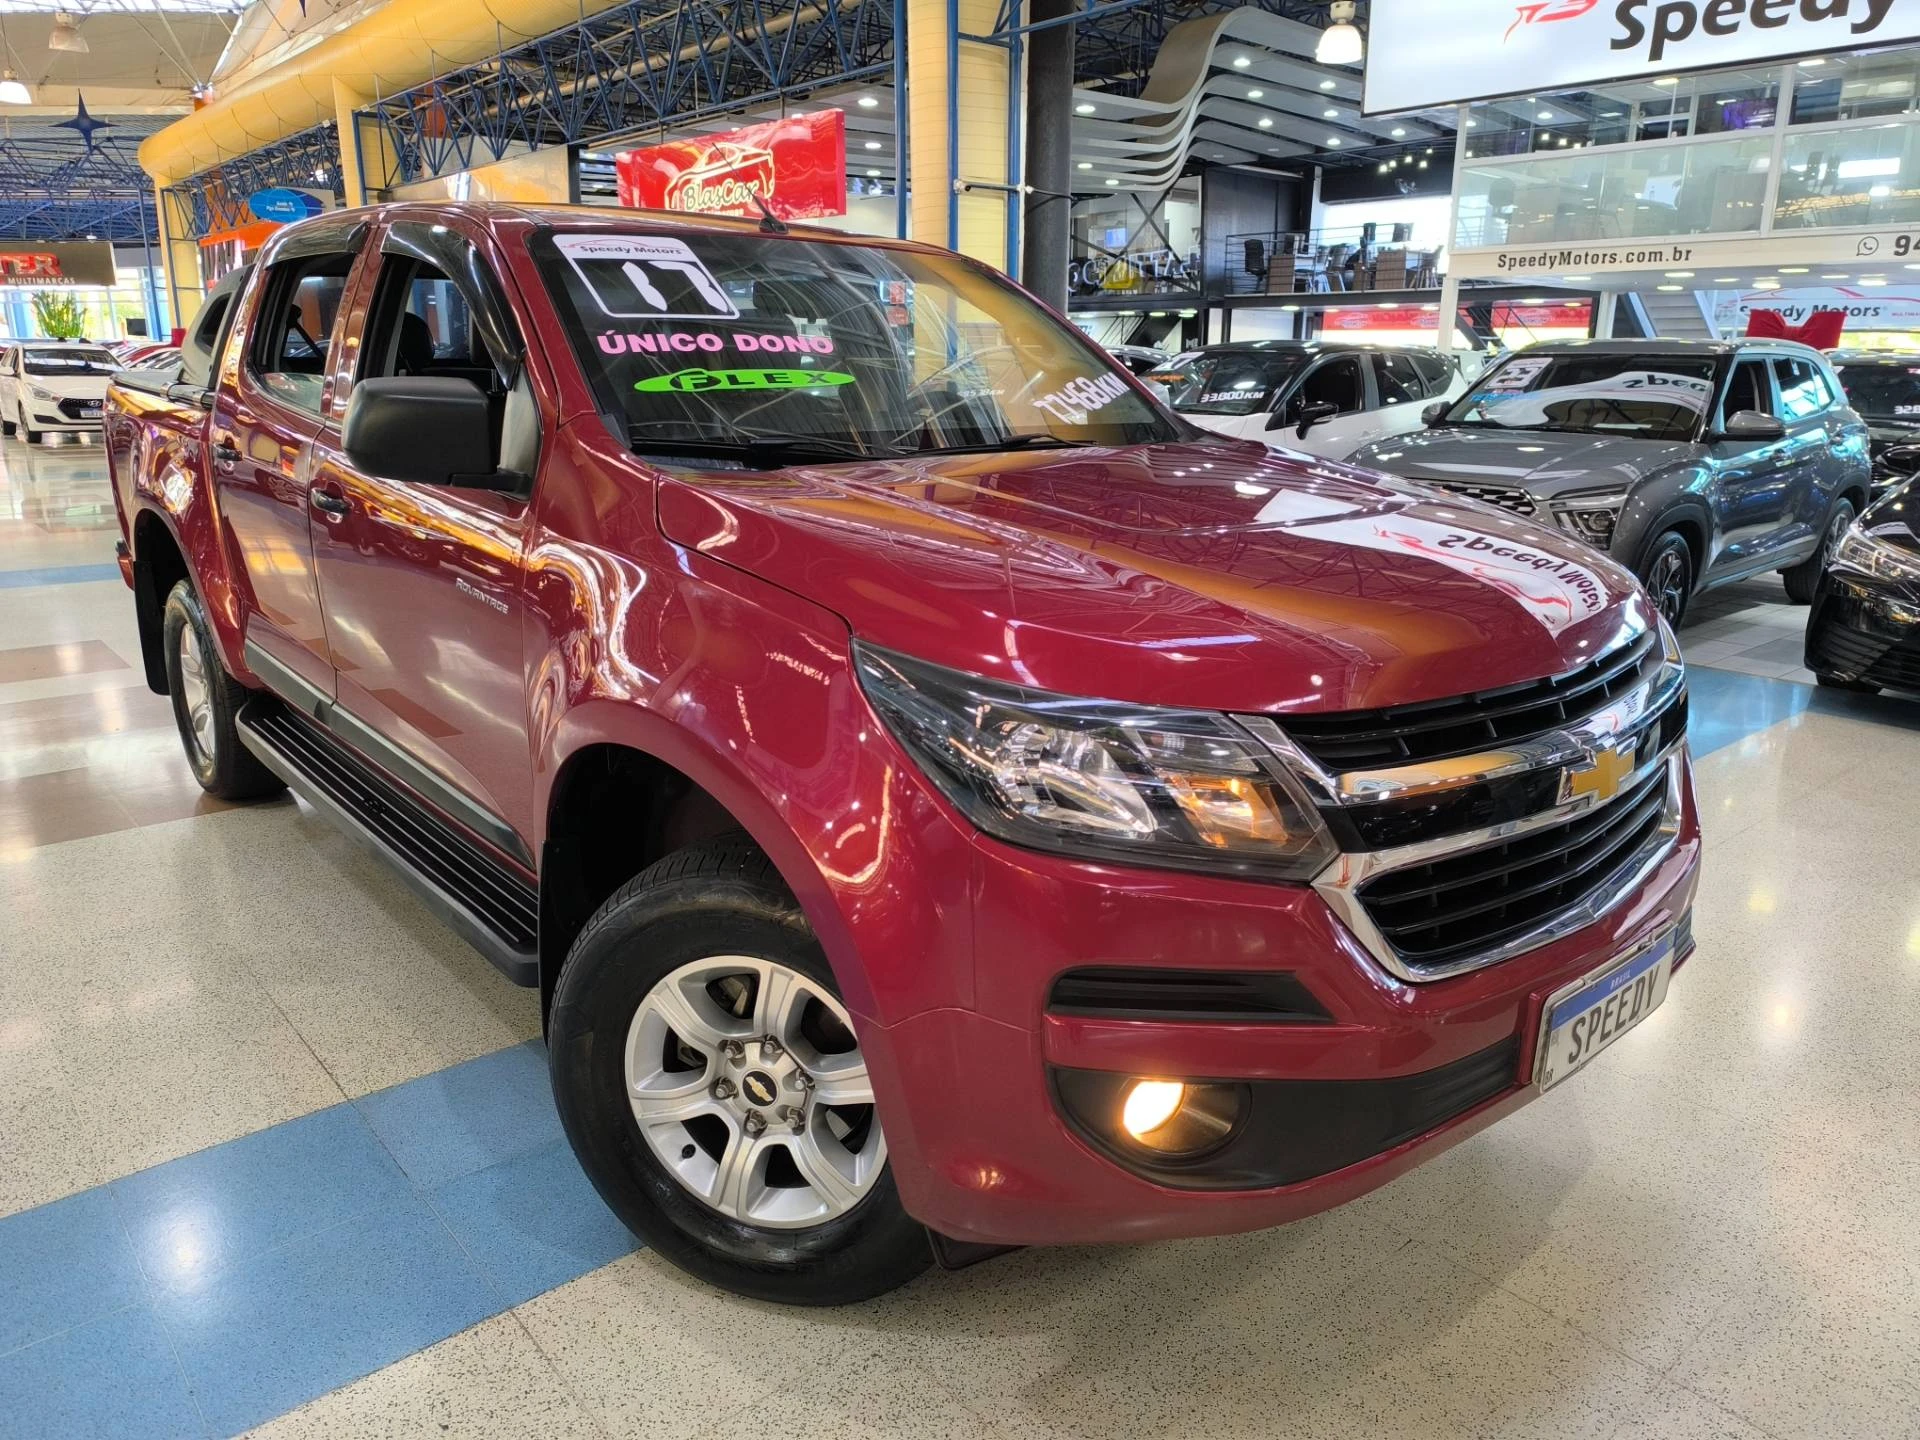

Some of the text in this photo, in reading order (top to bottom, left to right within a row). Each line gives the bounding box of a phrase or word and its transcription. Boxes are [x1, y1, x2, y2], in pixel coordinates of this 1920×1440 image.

[580, 245, 683, 255] Speedy Motors
[1497, 246, 1692, 270] SpeedyMotors.com.br
[8, 277, 76, 285] MULTIMARCAS
[1739, 304, 1806, 321] Sedy
[597, 330, 835, 354] ÚNICO DONO
[675, 372, 833, 389] FLEX
[456, 577, 509, 614] ADVANTAGE
[1568, 964, 1661, 1065] SPEEDY
